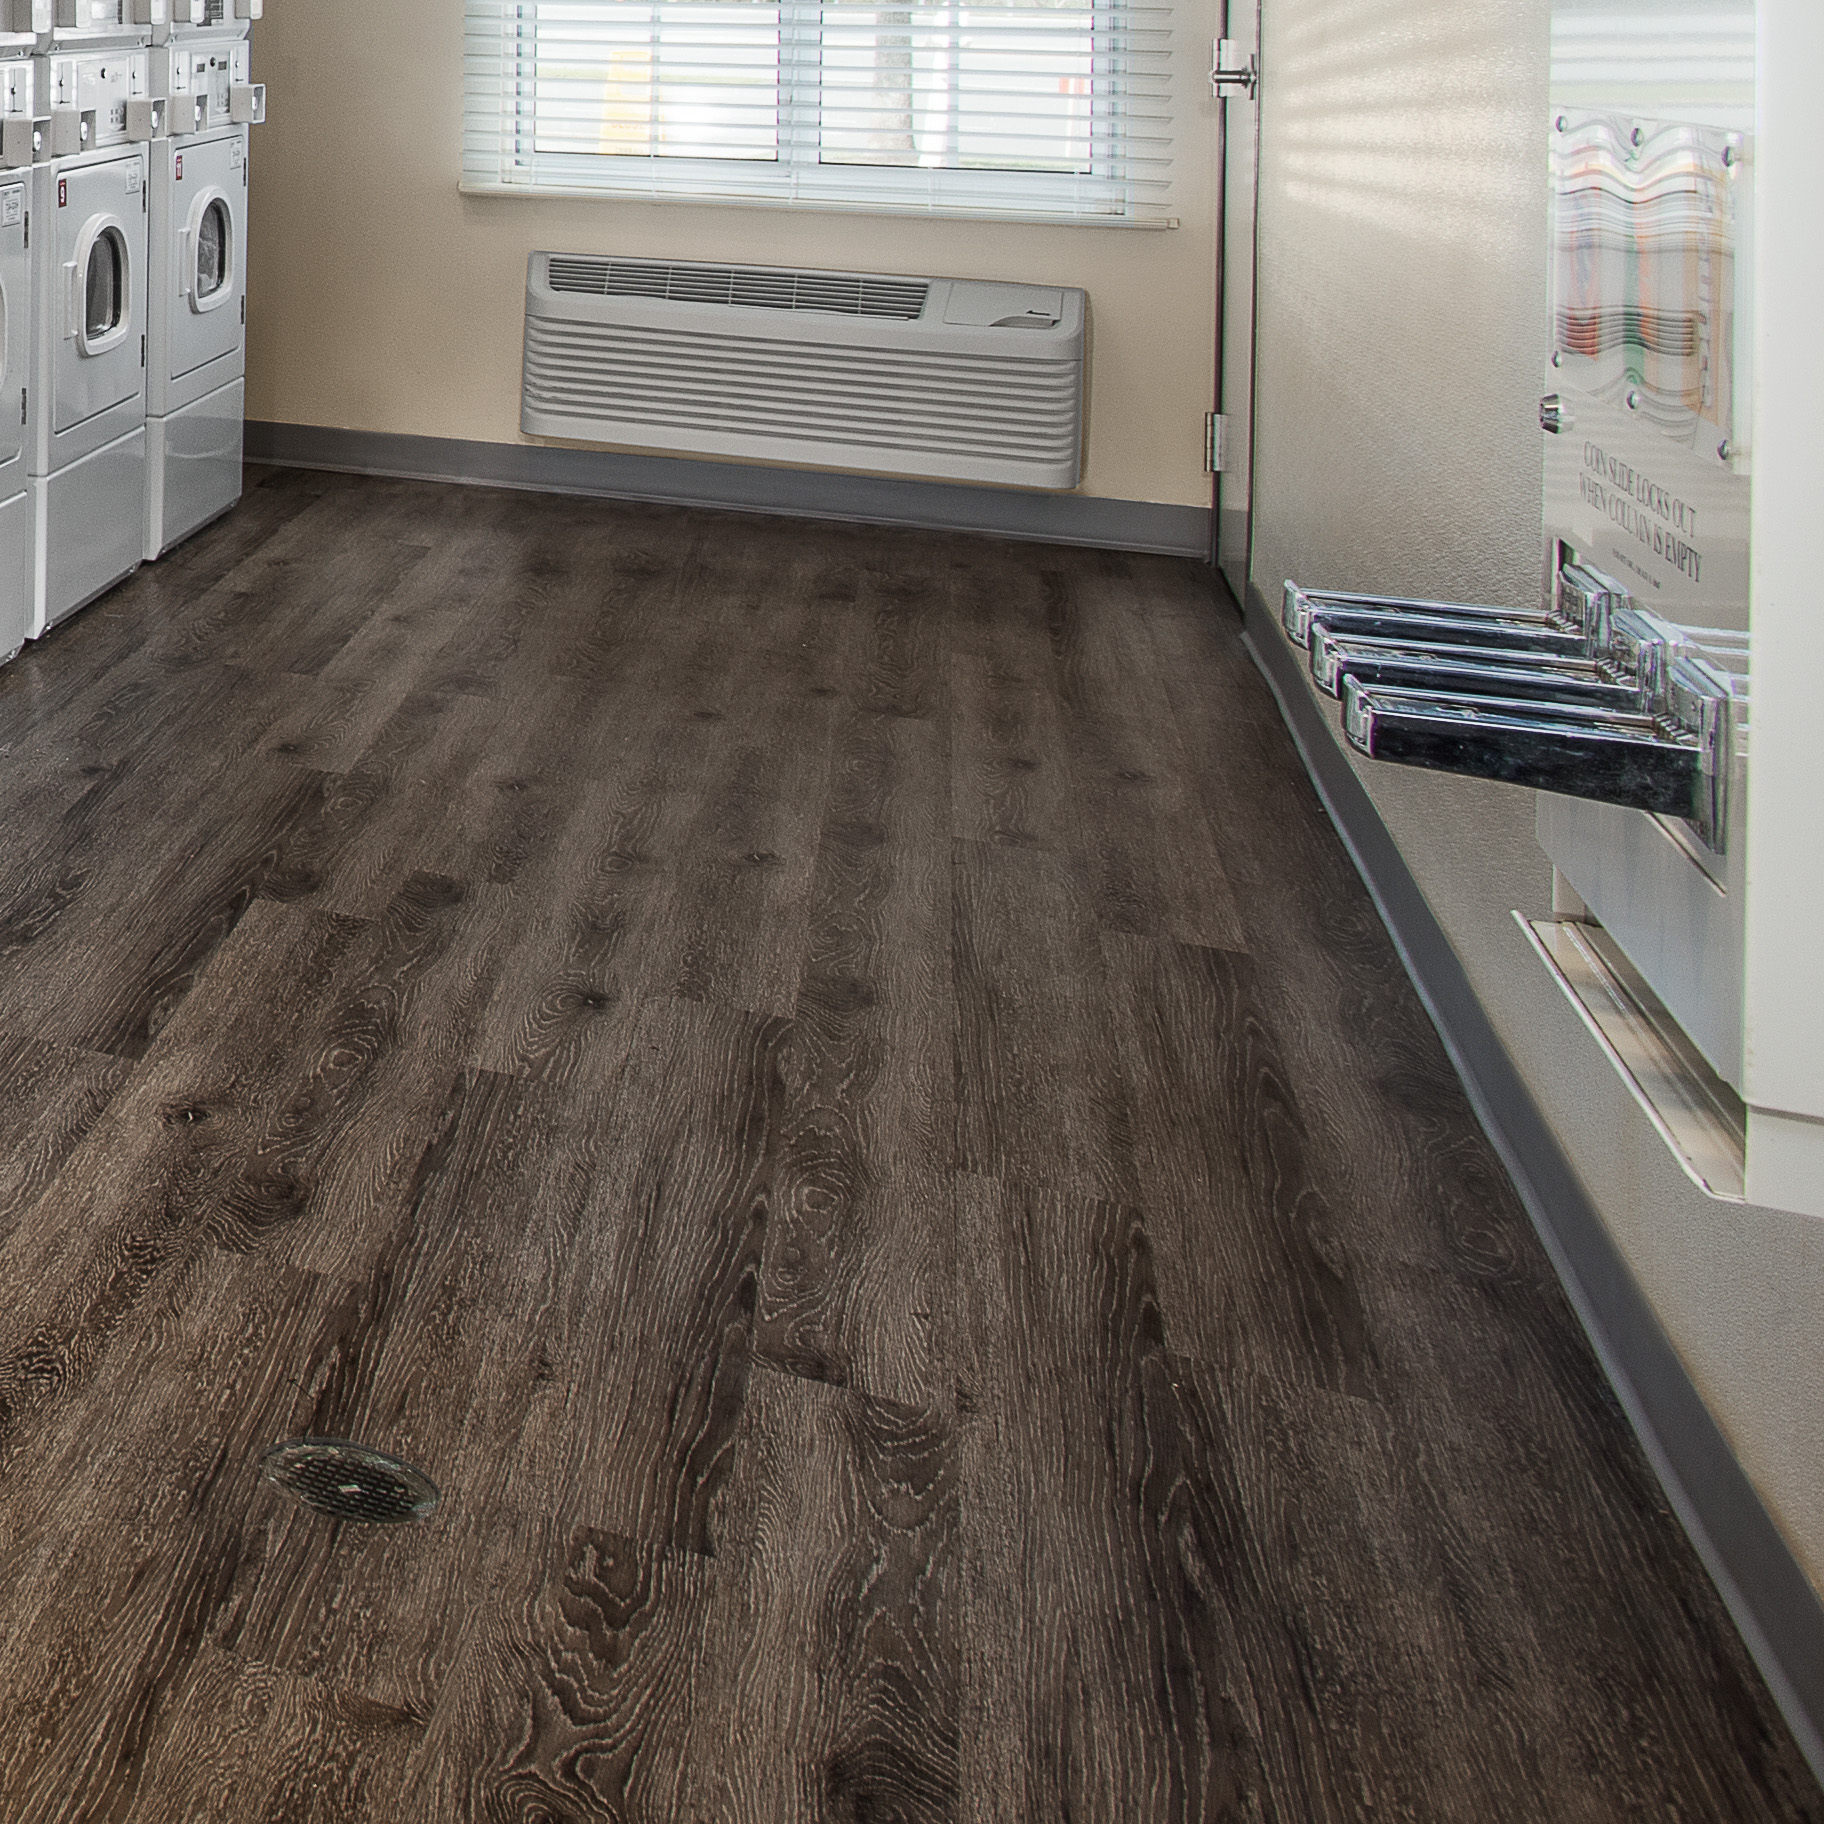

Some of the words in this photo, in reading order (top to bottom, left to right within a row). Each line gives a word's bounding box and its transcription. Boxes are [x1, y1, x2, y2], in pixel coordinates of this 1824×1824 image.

[60, 186, 65, 202] 9
[1580, 472, 1605, 512] WHEN
[1654, 524, 1661, 554] IS
[1665, 532, 1700, 582] EMPTY
[1584, 441, 1606, 476] COIN
[1609, 457, 1633, 496] SLIDE
[1637, 474, 1669, 520] LOCKS
[1673, 499, 1695, 538] OUT
